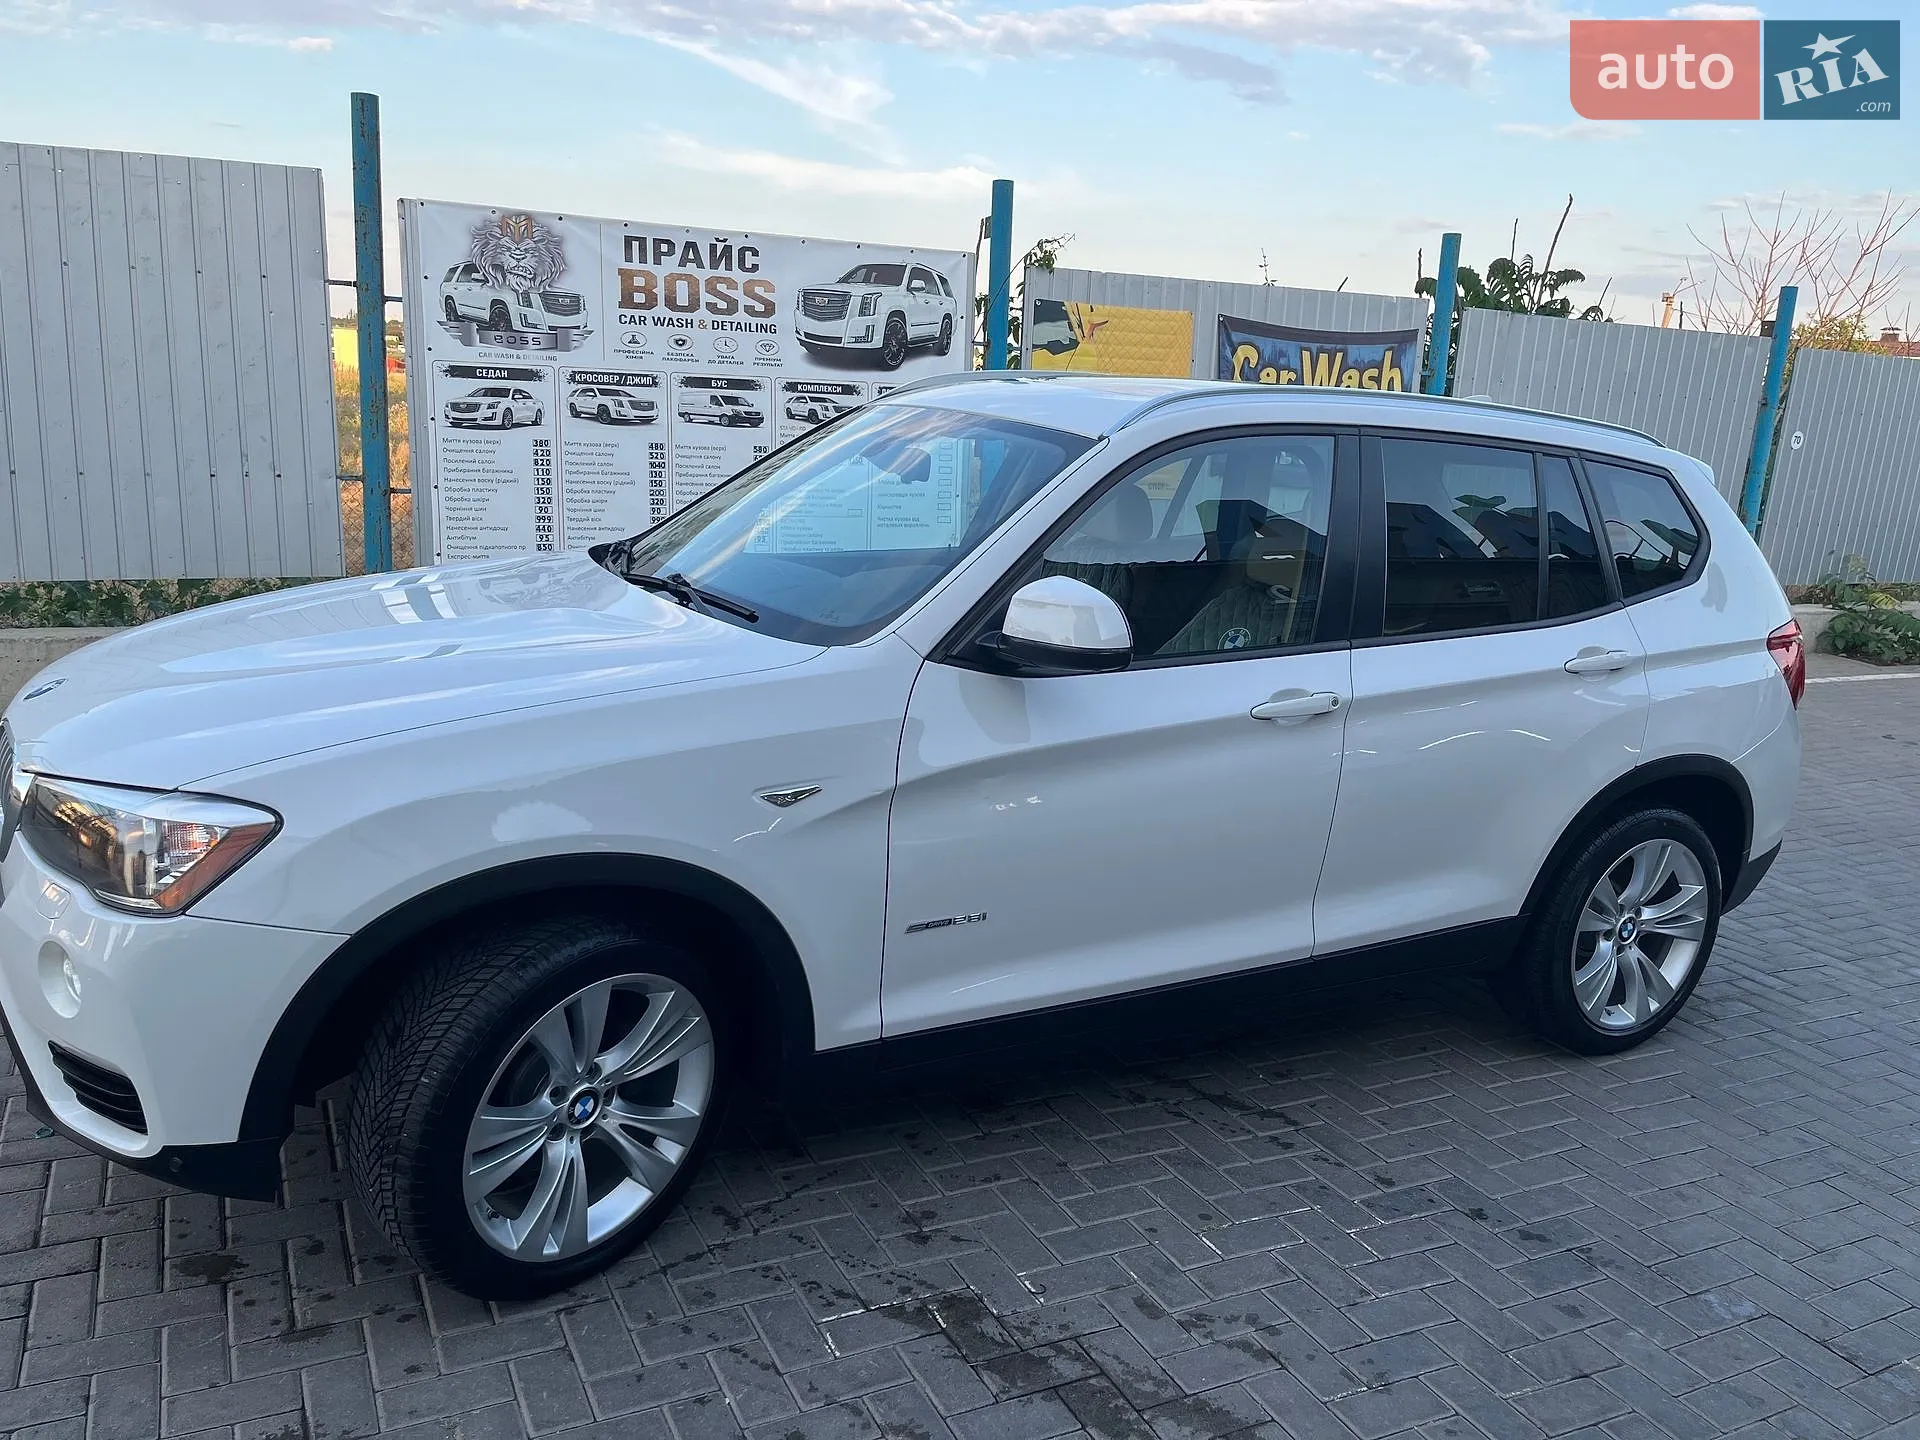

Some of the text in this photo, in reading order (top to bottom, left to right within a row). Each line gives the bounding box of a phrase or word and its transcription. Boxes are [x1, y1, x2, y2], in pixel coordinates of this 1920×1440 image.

[623, 235, 760, 273] ПРАЙС
[617, 268, 776, 319] BOSS
[618, 314, 777, 334] CAR WASH & DETAILING
[494, 334, 541, 345] BOSS
[1232, 344, 1402, 392] Car Wash
[476, 368, 508, 378] СЕДАН
[575, 373, 620, 384] КРОСОВЕР
[626, 376, 653, 386] ДЖИП
[711, 379, 728, 388] БУС
[797, 383, 842, 393] КОМПЛЕКСИ
[533, 439, 549, 447] 380
[533, 449, 551, 457] 420
[535, 468, 551, 476] 110
[535, 487, 551, 495] 150
[538, 506, 549, 514] 90
[651, 507, 661, 515] 90
[536, 525, 552, 533] 440
[538, 534, 550, 542] 95
